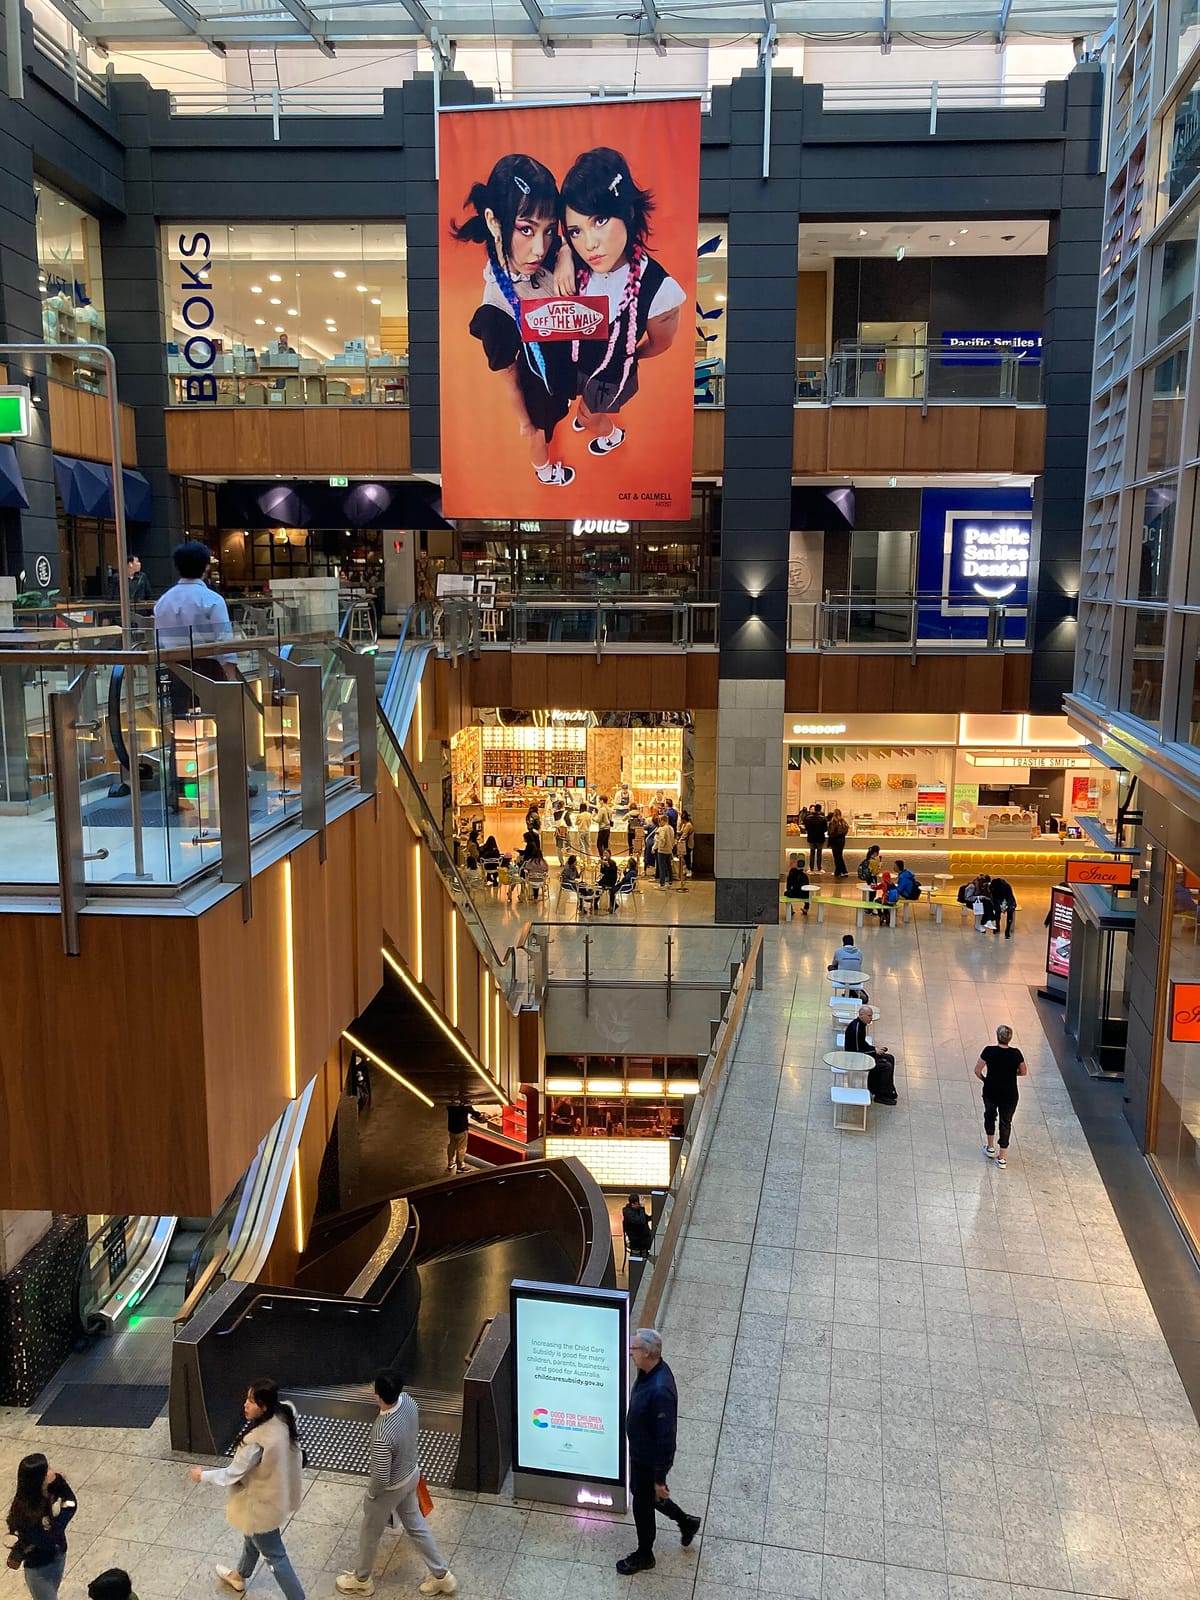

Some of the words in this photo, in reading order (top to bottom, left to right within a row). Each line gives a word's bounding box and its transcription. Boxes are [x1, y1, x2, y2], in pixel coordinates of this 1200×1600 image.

[547, 303, 576, 315] VANS
[179, 232, 217, 401] BOOKS
[551, 315, 572, 329] THE
[950, 337, 990, 346] Pacific
[993, 337, 1034, 347] Smiles
[965, 528, 1030, 545] Pacific
[964, 545, 1029, 560] Smiles
[963, 560, 1027, 576] Dental
[1079, 867, 1117, 881] Incu
[531, 1339, 562, 1350] Increasing
[574, 1344, 589, 1352] Child
[590, 1346, 604, 1354] Care
[532, 1347, 555, 1357] Subsidy
[588, 1355, 606, 1363] many
[577, 1362, 610, 1371] businesses
[534, 1373, 604, 1387] childcaresubsidy.gov.au
[550, 1411, 565, 1419] GOOD
[566, 1412, 576, 1420] FOR
[577, 1414, 603, 1423] CHILDREN
[550, 1418, 565, 1426] GOOD
[566, 1419, 576, 1427] FOR
[577, 1421, 605, 1431] AUSTRALIA
